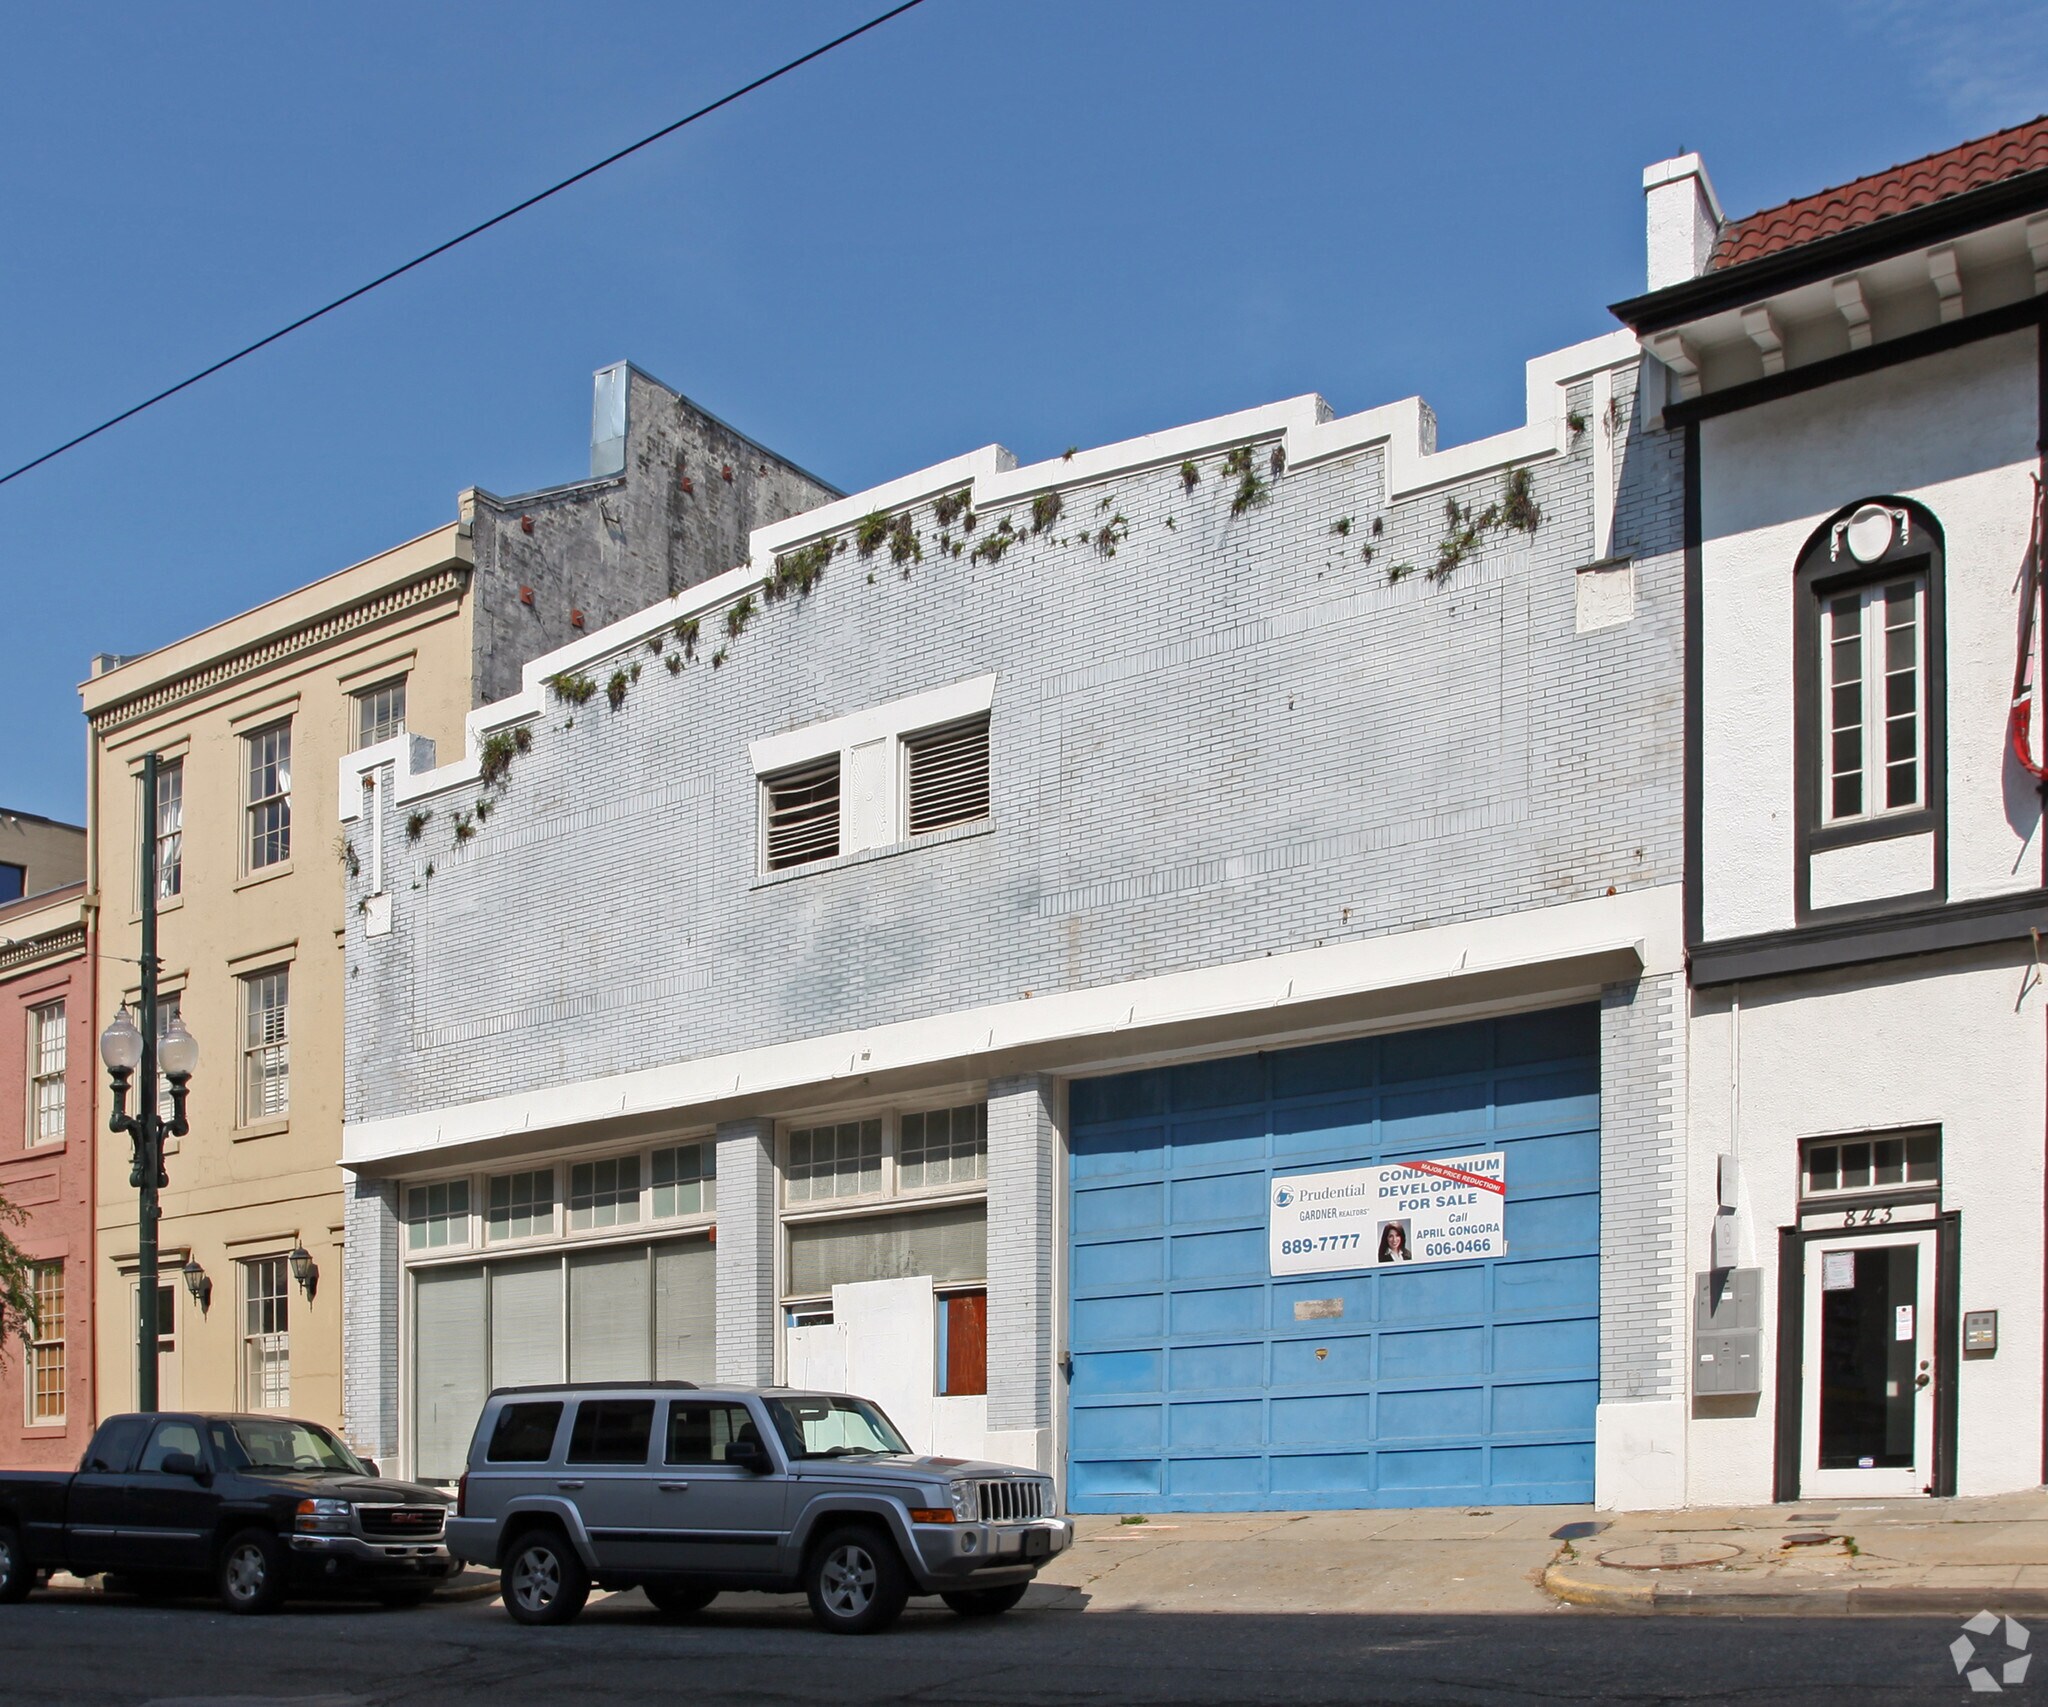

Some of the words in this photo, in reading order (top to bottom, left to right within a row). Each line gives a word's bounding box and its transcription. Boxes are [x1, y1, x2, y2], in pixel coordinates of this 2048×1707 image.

[1379, 1159, 1499, 1182] CONDNIUM
[1421, 1163, 1443, 1174] MAJOR
[1443, 1169, 1462, 1180] PRICE
[1299, 1183, 1366, 1202] Prudential
[1378, 1174, 1500, 1198] DEVELOPMT
[1399, 1198, 1430, 1211] FOR
[1436, 1193, 1477, 1208] SALE
[1299, 1208, 1338, 1221] GARDNER
[1448, 1212, 1468, 1223] Call
[1844, 1204, 1893, 1228] 843
[1416, 1229, 1446, 1240] APRIL
[1448, 1223, 1500, 1237] GONGORA
[1282, 1233, 1360, 1255] 889-7777
[1426, 1239, 1491, 1256] 606-0466
[391, 1512, 423, 1524] GMC
